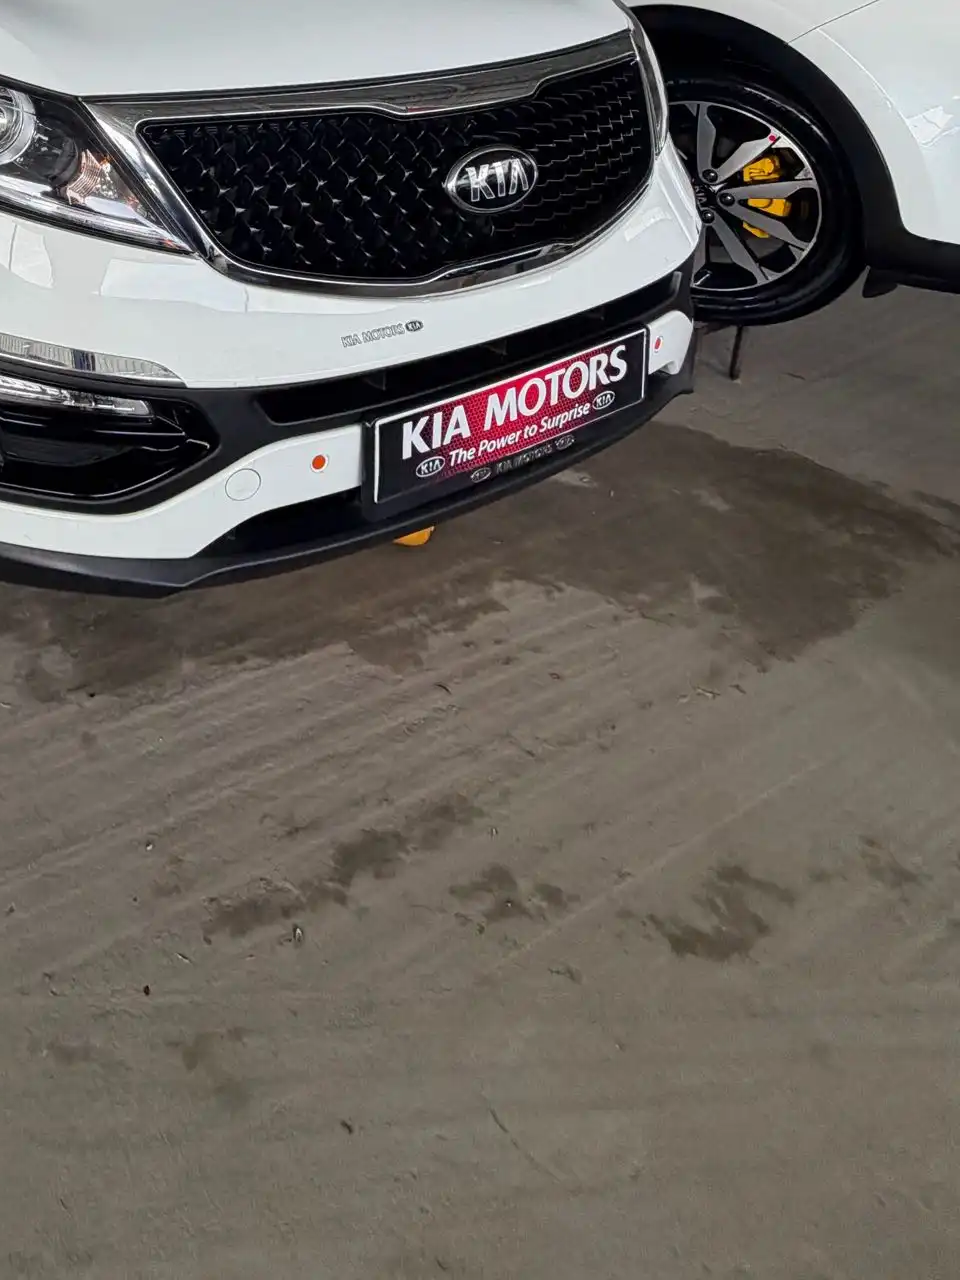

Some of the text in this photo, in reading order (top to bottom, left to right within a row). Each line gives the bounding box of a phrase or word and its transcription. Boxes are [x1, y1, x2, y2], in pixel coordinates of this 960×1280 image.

[465, 158, 529, 202] KIA
[341, 333, 362, 348] KIA
[362, 323, 405, 343] MOTORS
[402, 345, 628, 460] KIA MOTORS
[420, 393, 614, 476] KIA The Power to Surprise KIA
